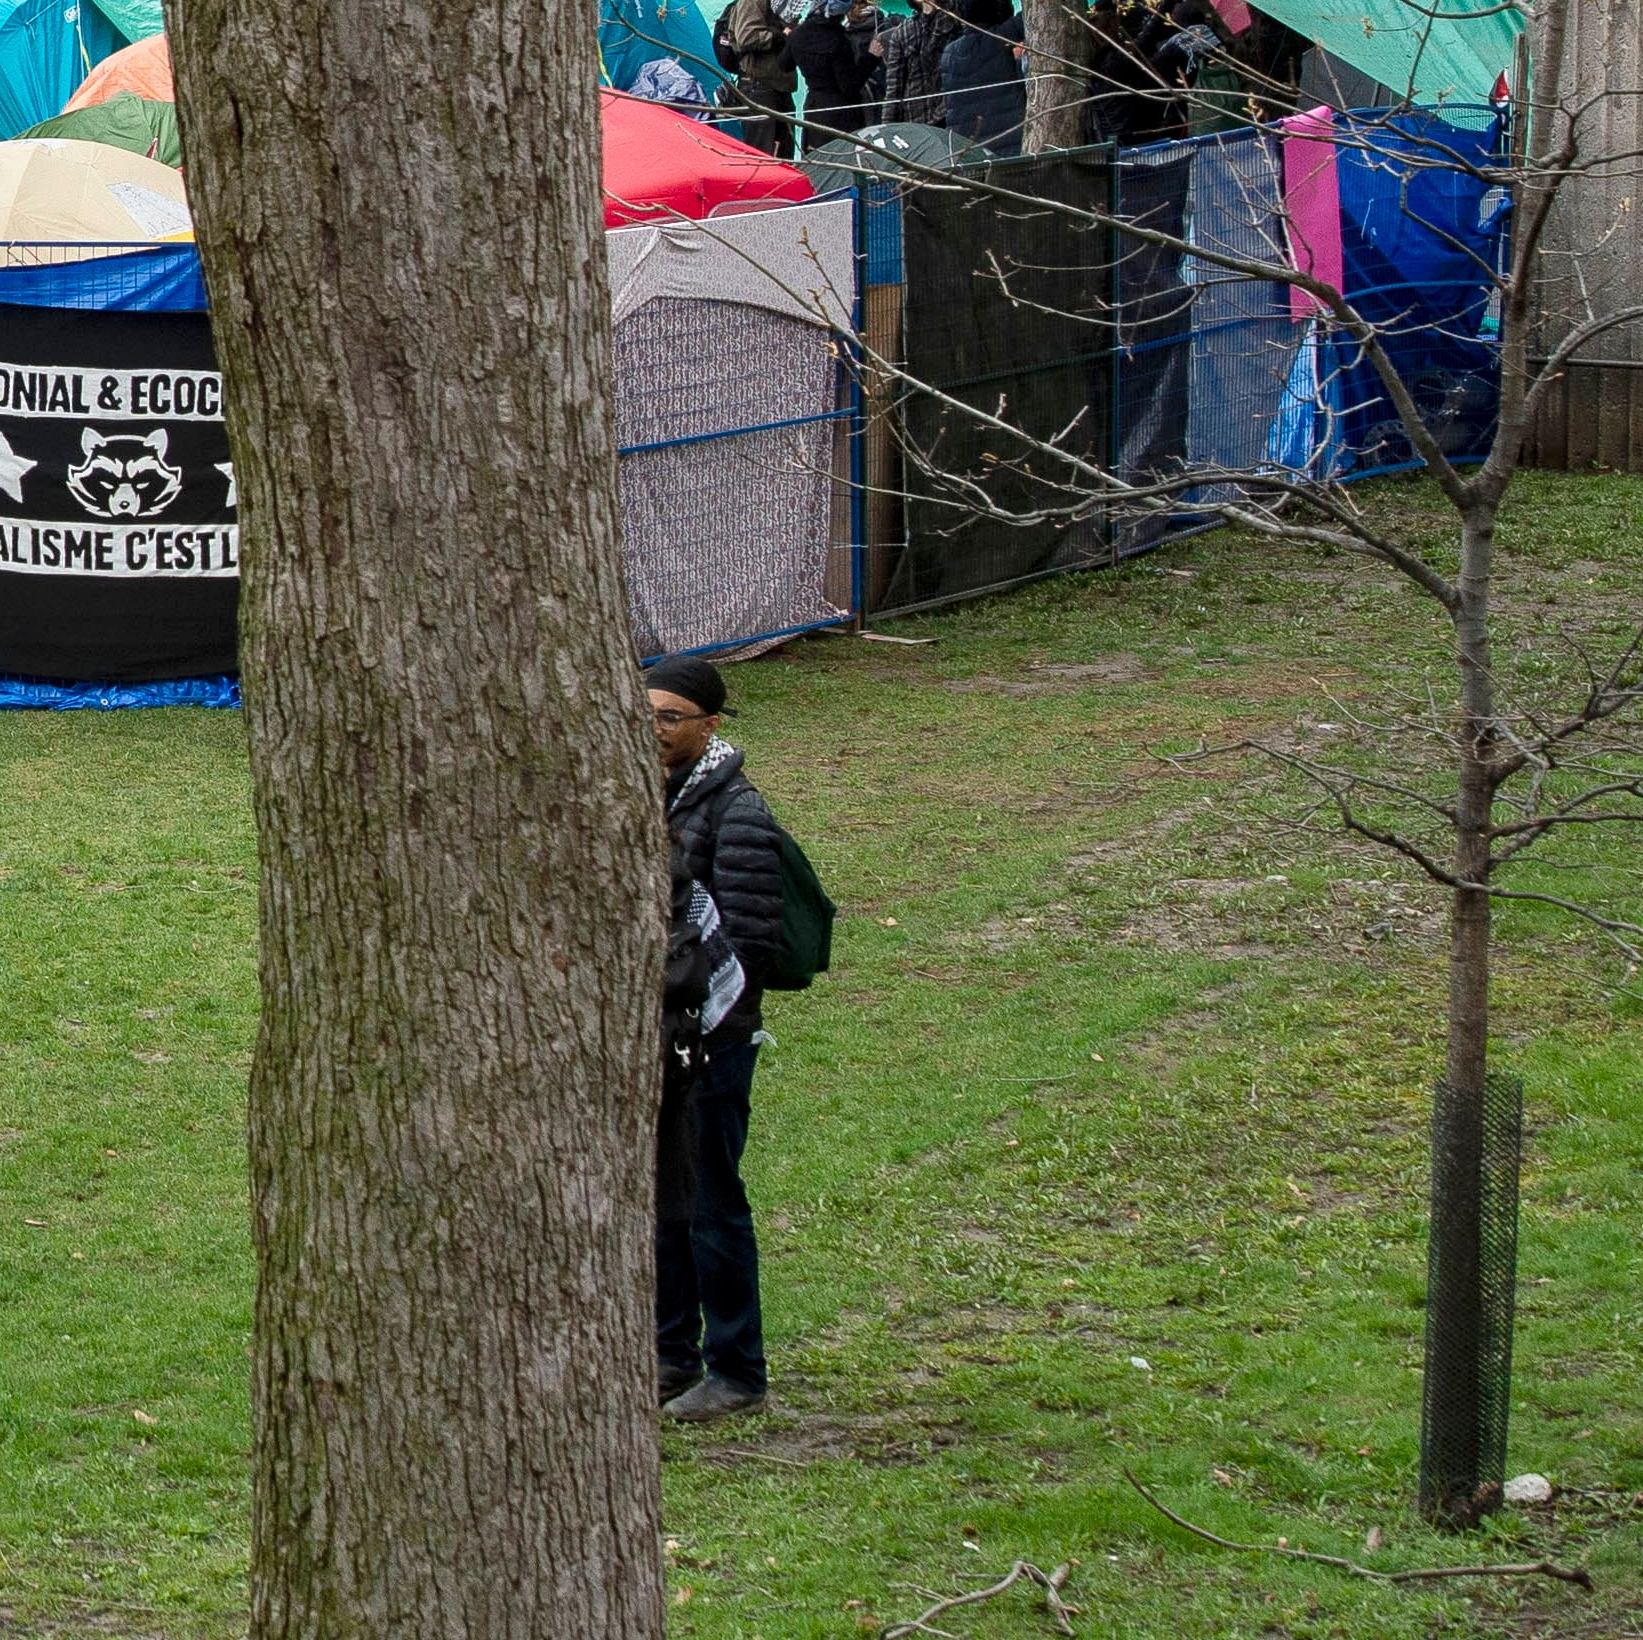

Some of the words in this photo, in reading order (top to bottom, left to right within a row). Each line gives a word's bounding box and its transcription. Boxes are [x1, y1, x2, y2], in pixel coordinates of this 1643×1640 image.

[97, 374, 123, 411] &
[130, 373, 224, 417] ECOC
[125, 527, 216, 571] C'EST
